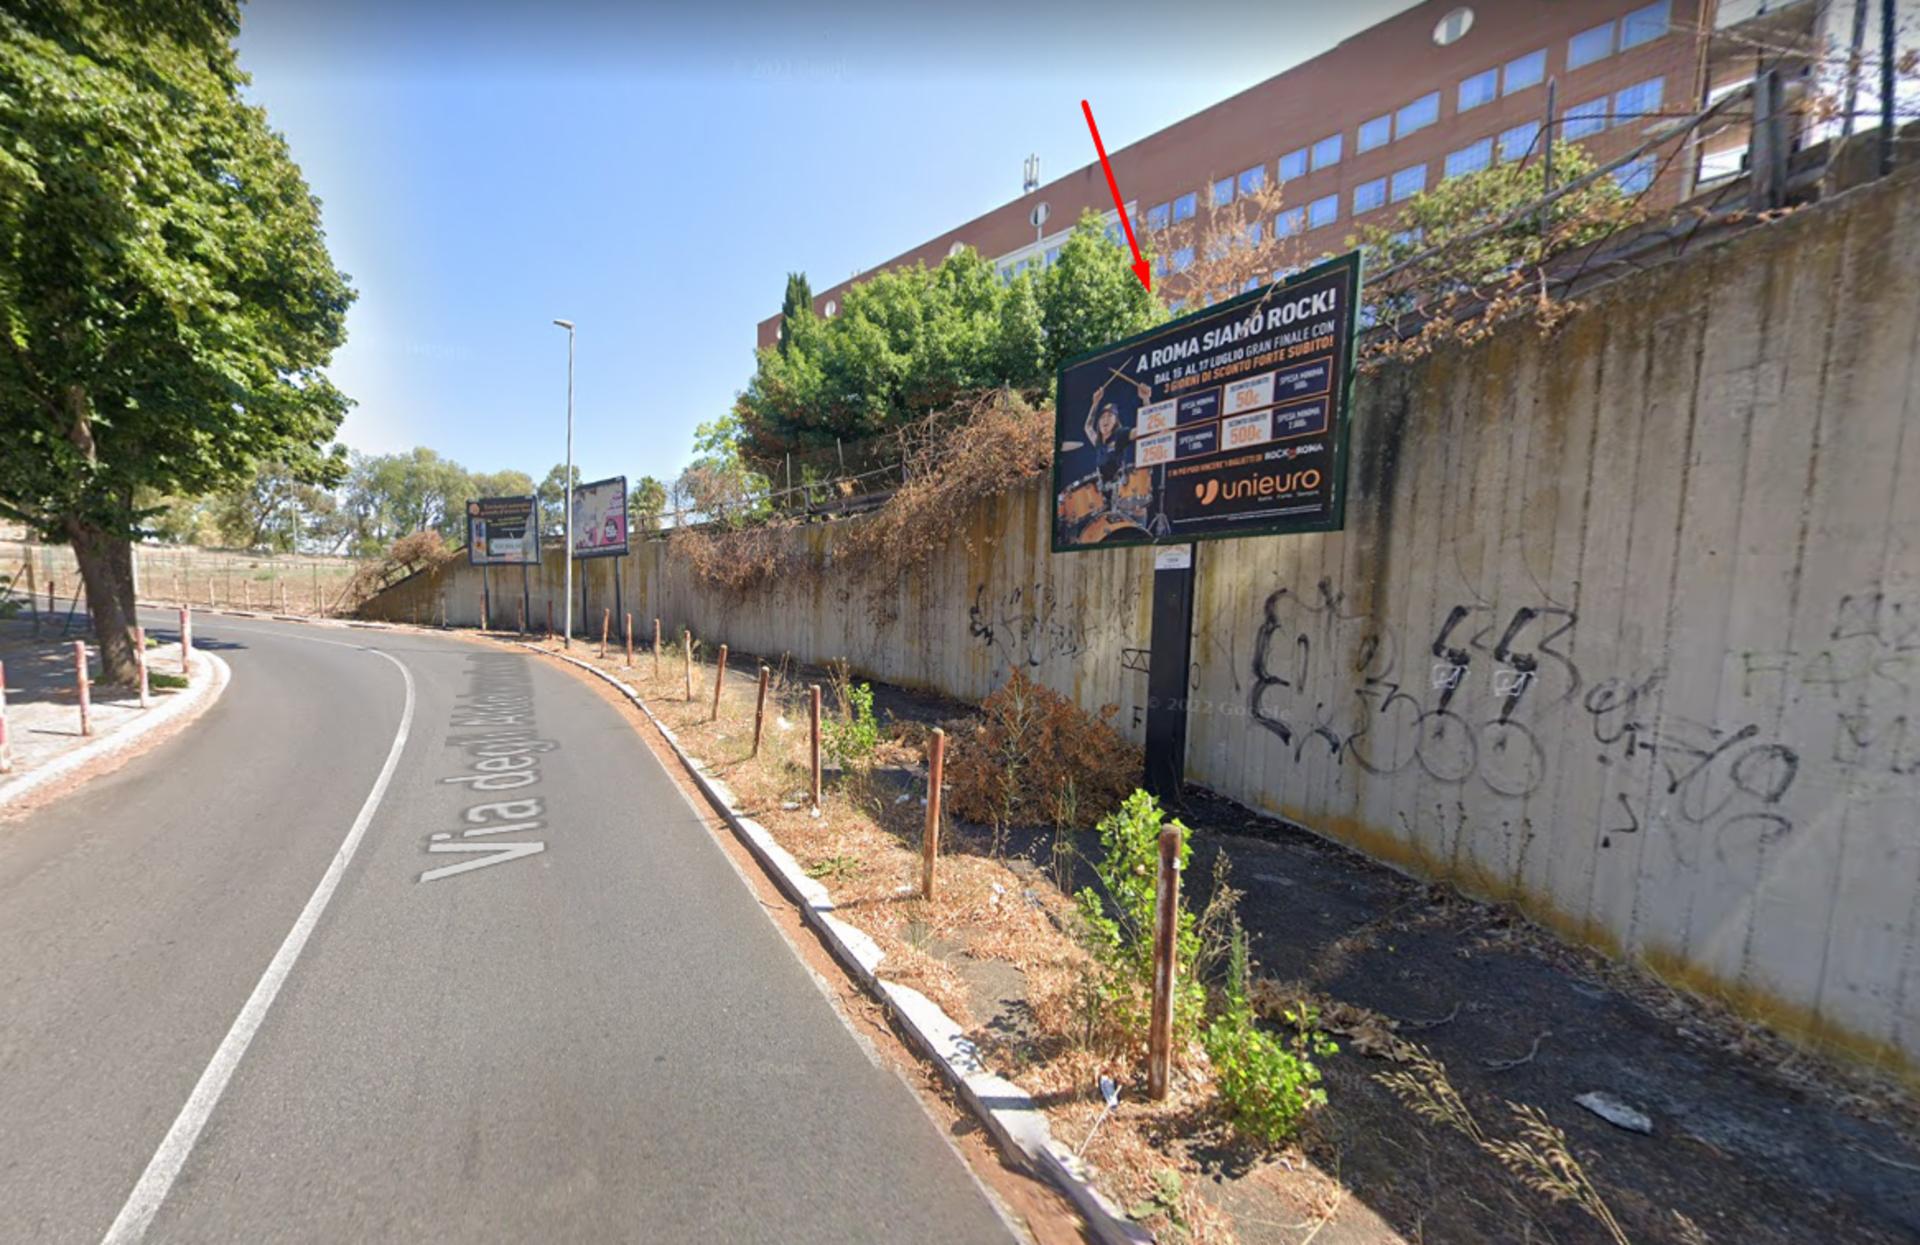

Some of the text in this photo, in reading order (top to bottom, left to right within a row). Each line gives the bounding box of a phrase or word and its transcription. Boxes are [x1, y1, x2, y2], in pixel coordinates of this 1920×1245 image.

[1136, 287, 1336, 374] A ROMA SIAMO ROCK!
[1154, 372, 1171, 385] DAL
[1185, 363, 1197, 376] AL
[1199, 358, 1209, 371] 17
[1210, 348, 1244, 369] LUGLIO
[1246, 339, 1272, 356] GRAN
[1274, 326, 1310, 349] FINALE
[1312, 319, 1335, 337] CON
[1170, 377, 1200, 391] GIORNI
[1201, 371, 1212, 383] DI
[1213, 359, 1251, 380] SCONTO
[1253, 348, 1286, 368] FORTE
[1287, 334, 1334, 358] SUBITO!
[1222, 468, 1321, 500] unieuro
